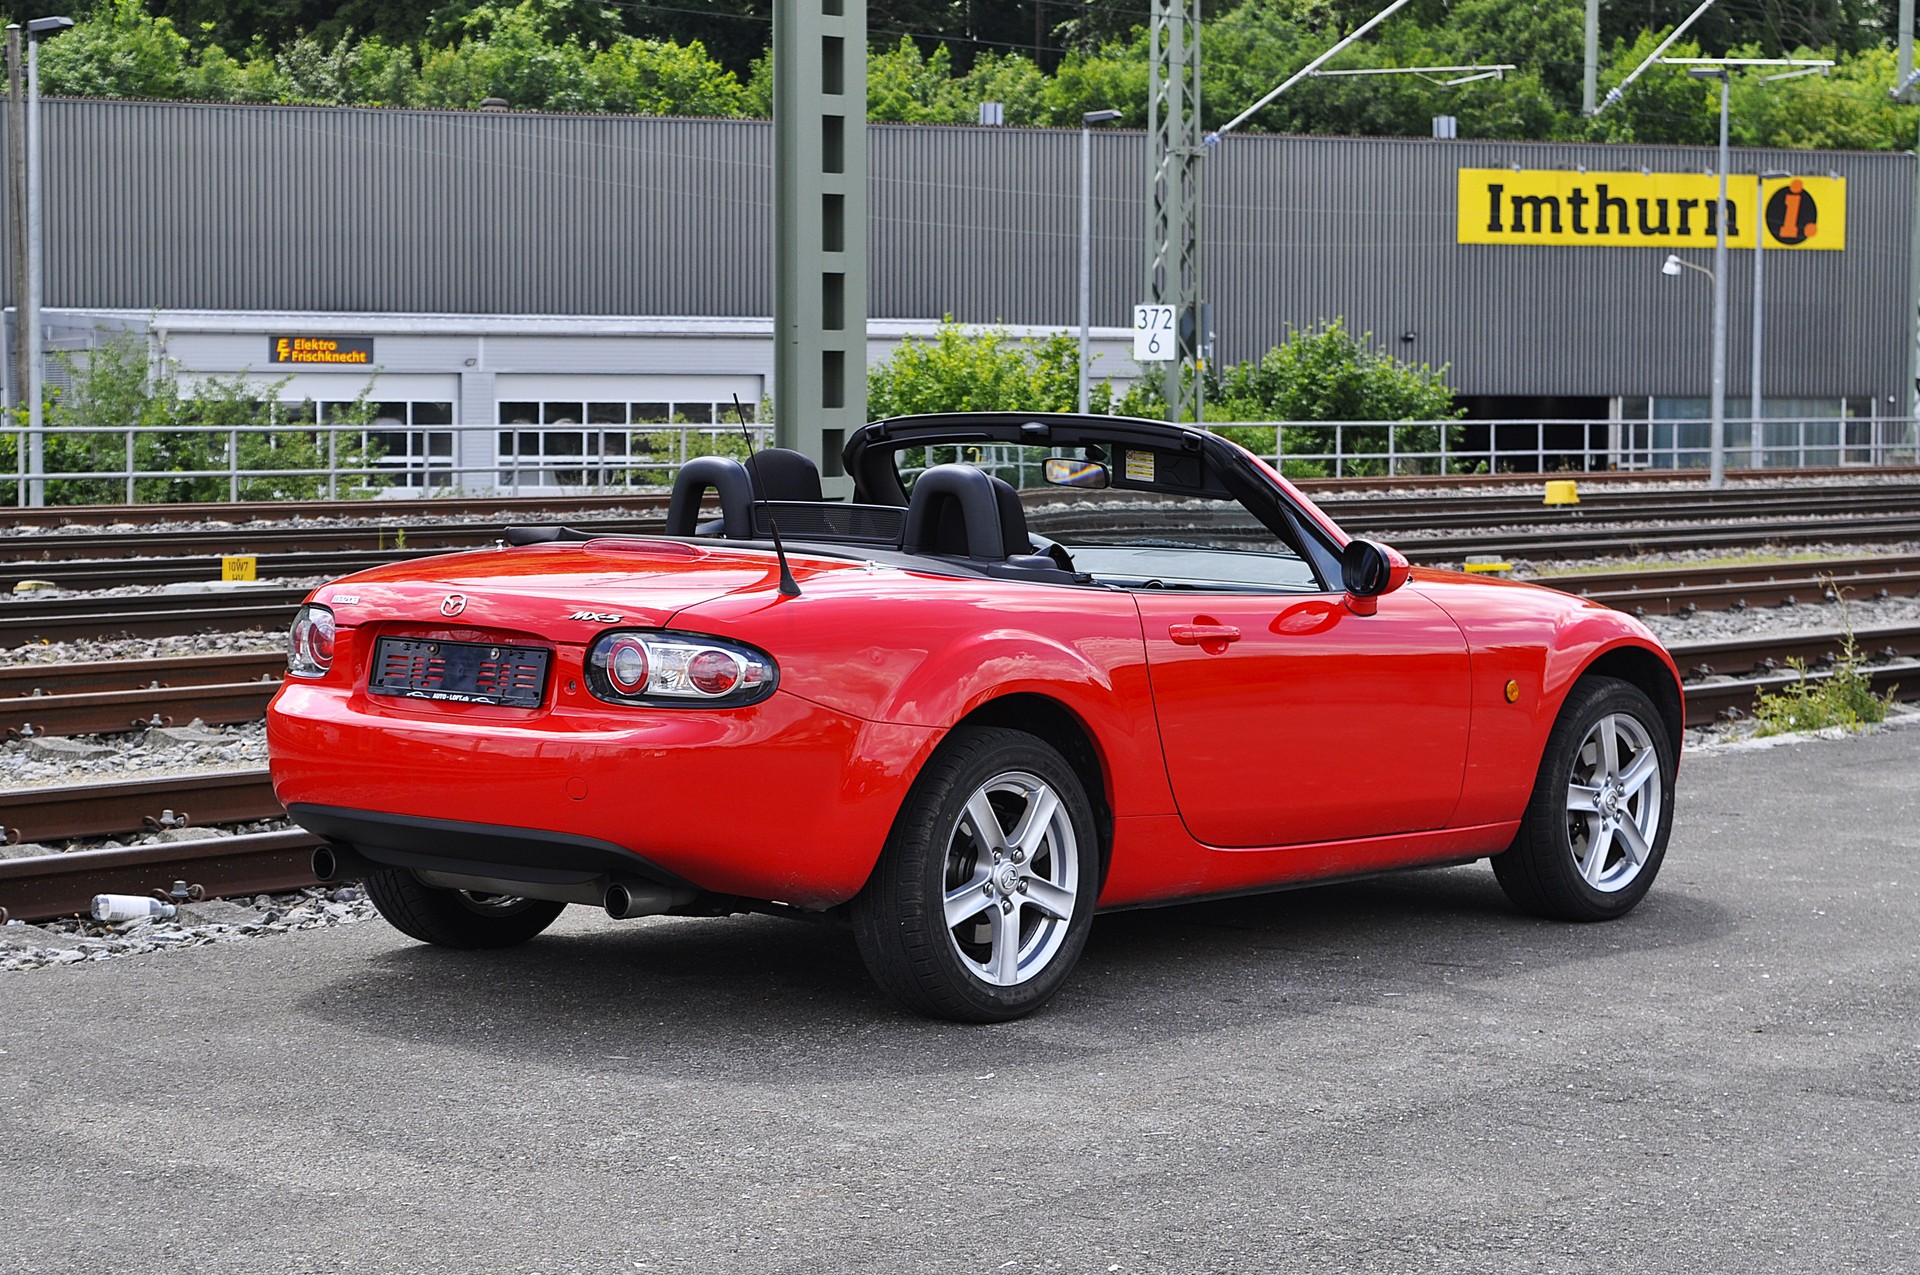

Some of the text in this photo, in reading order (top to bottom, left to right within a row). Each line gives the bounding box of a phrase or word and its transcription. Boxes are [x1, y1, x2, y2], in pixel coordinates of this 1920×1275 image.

[1487, 183, 1739, 237] Imthurn
[1138, 308, 1172, 330] 372
[294, 338, 337, 351] Elektro
[1148, 333, 1160, 354] 6
[292, 350, 367, 363] Frischknecht
